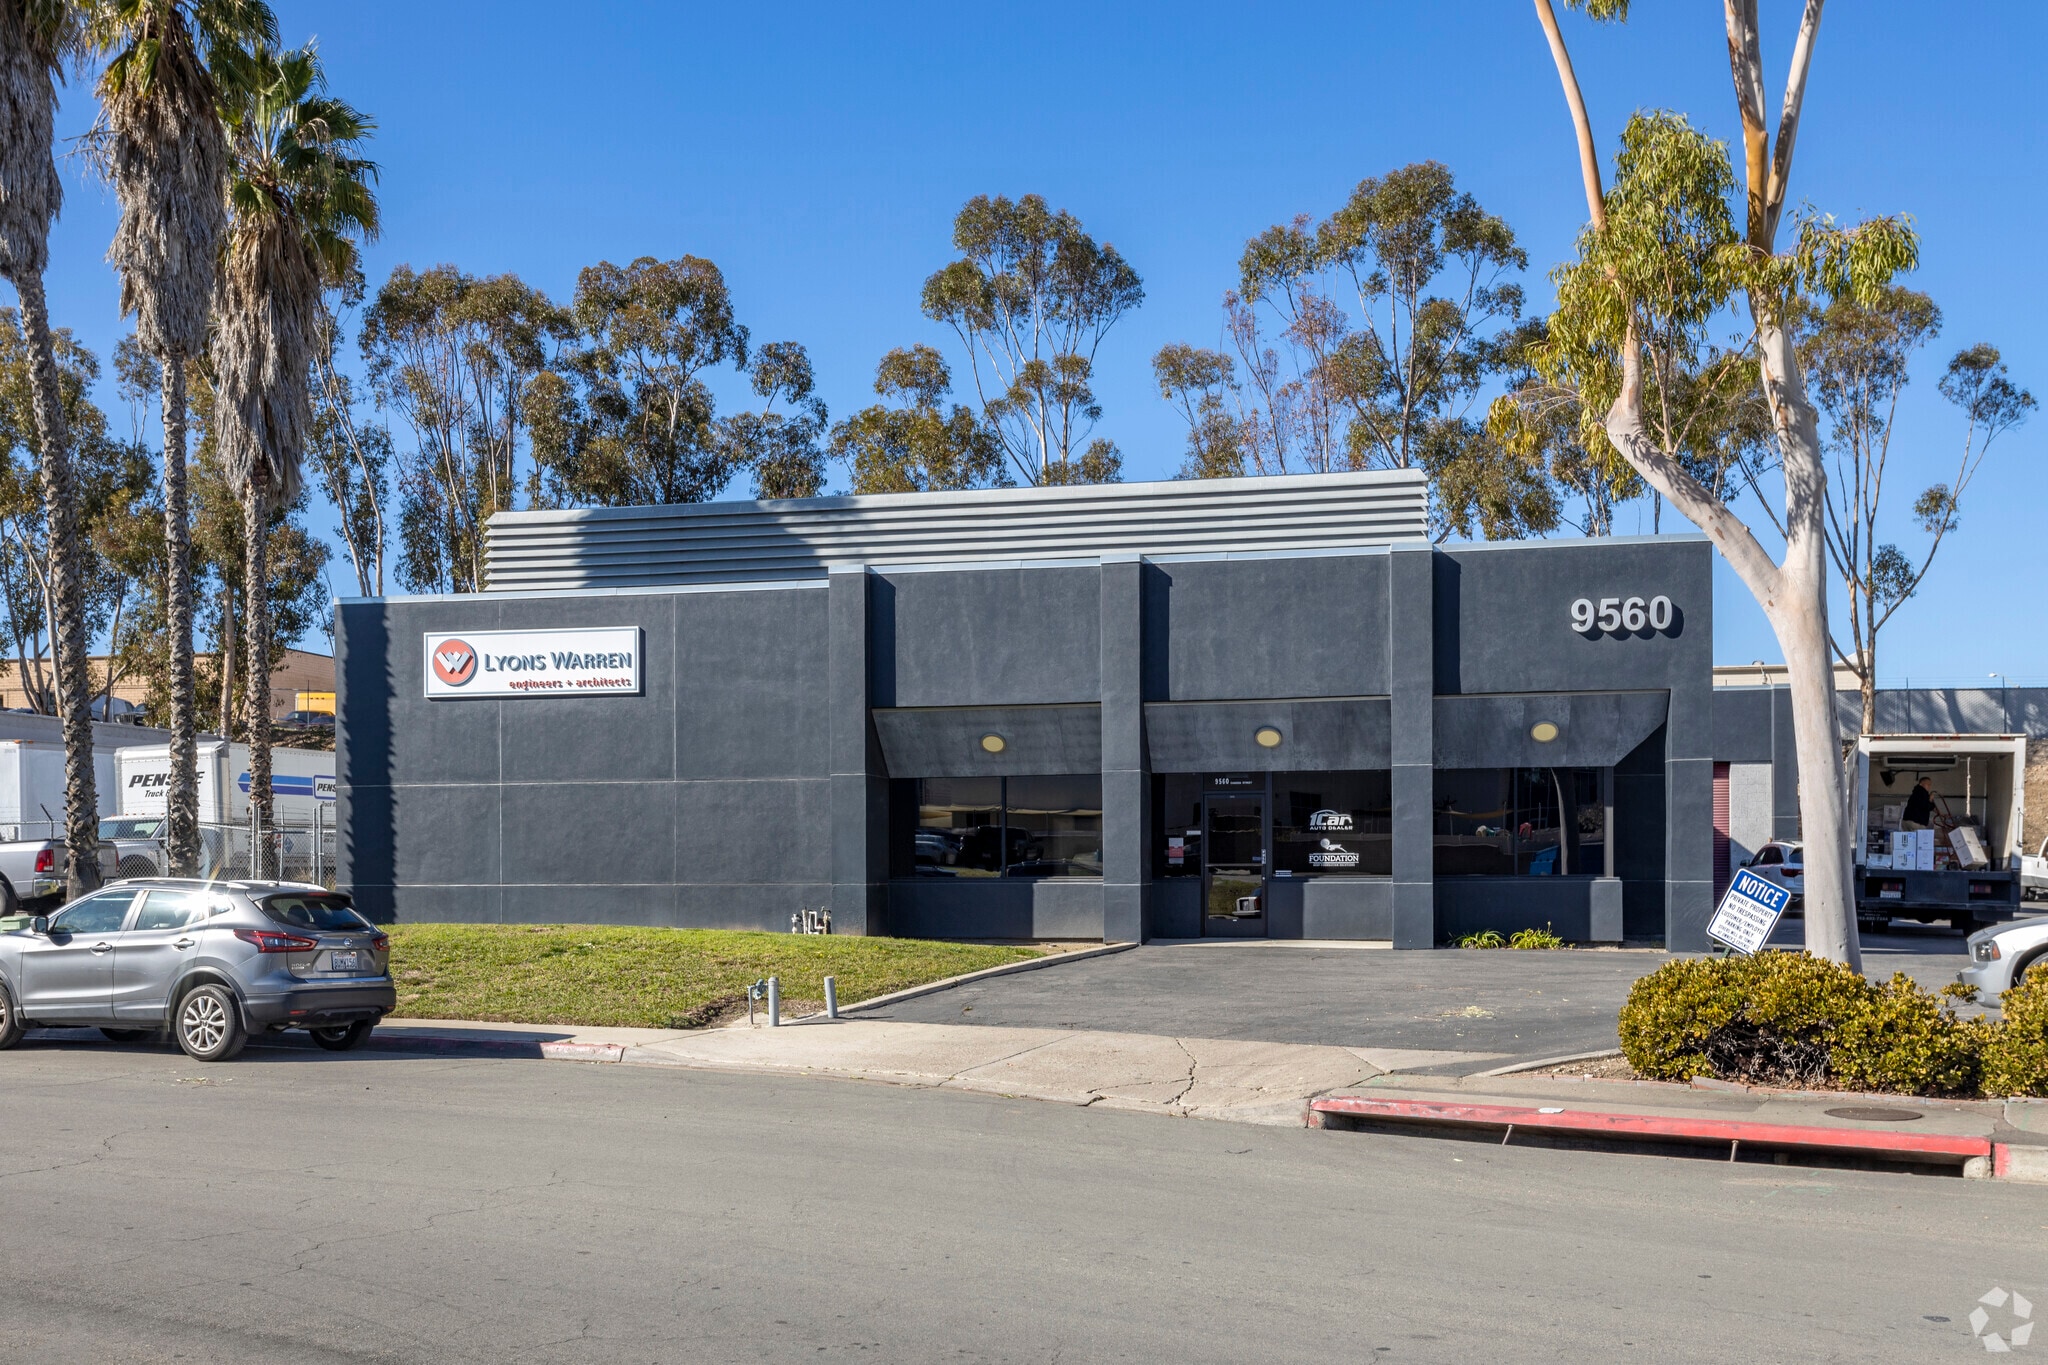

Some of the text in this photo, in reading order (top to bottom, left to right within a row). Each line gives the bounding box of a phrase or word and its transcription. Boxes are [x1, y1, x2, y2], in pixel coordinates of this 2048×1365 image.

[1571, 595, 1672, 632] 9560
[484, 651, 632, 671] LYONS WARREN
[509, 679, 564, 691] engineers
[576, 677, 632, 688] architects
[144, 790, 164, 798] Truck
[1737, 874, 1782, 908] NOTICE
[1729, 893, 1773, 919] PRIVATE PROPERTY
[1736, 907, 1766, 926] TRESPASSING
[1724, 919, 1754, 937] PARKING ONLY
